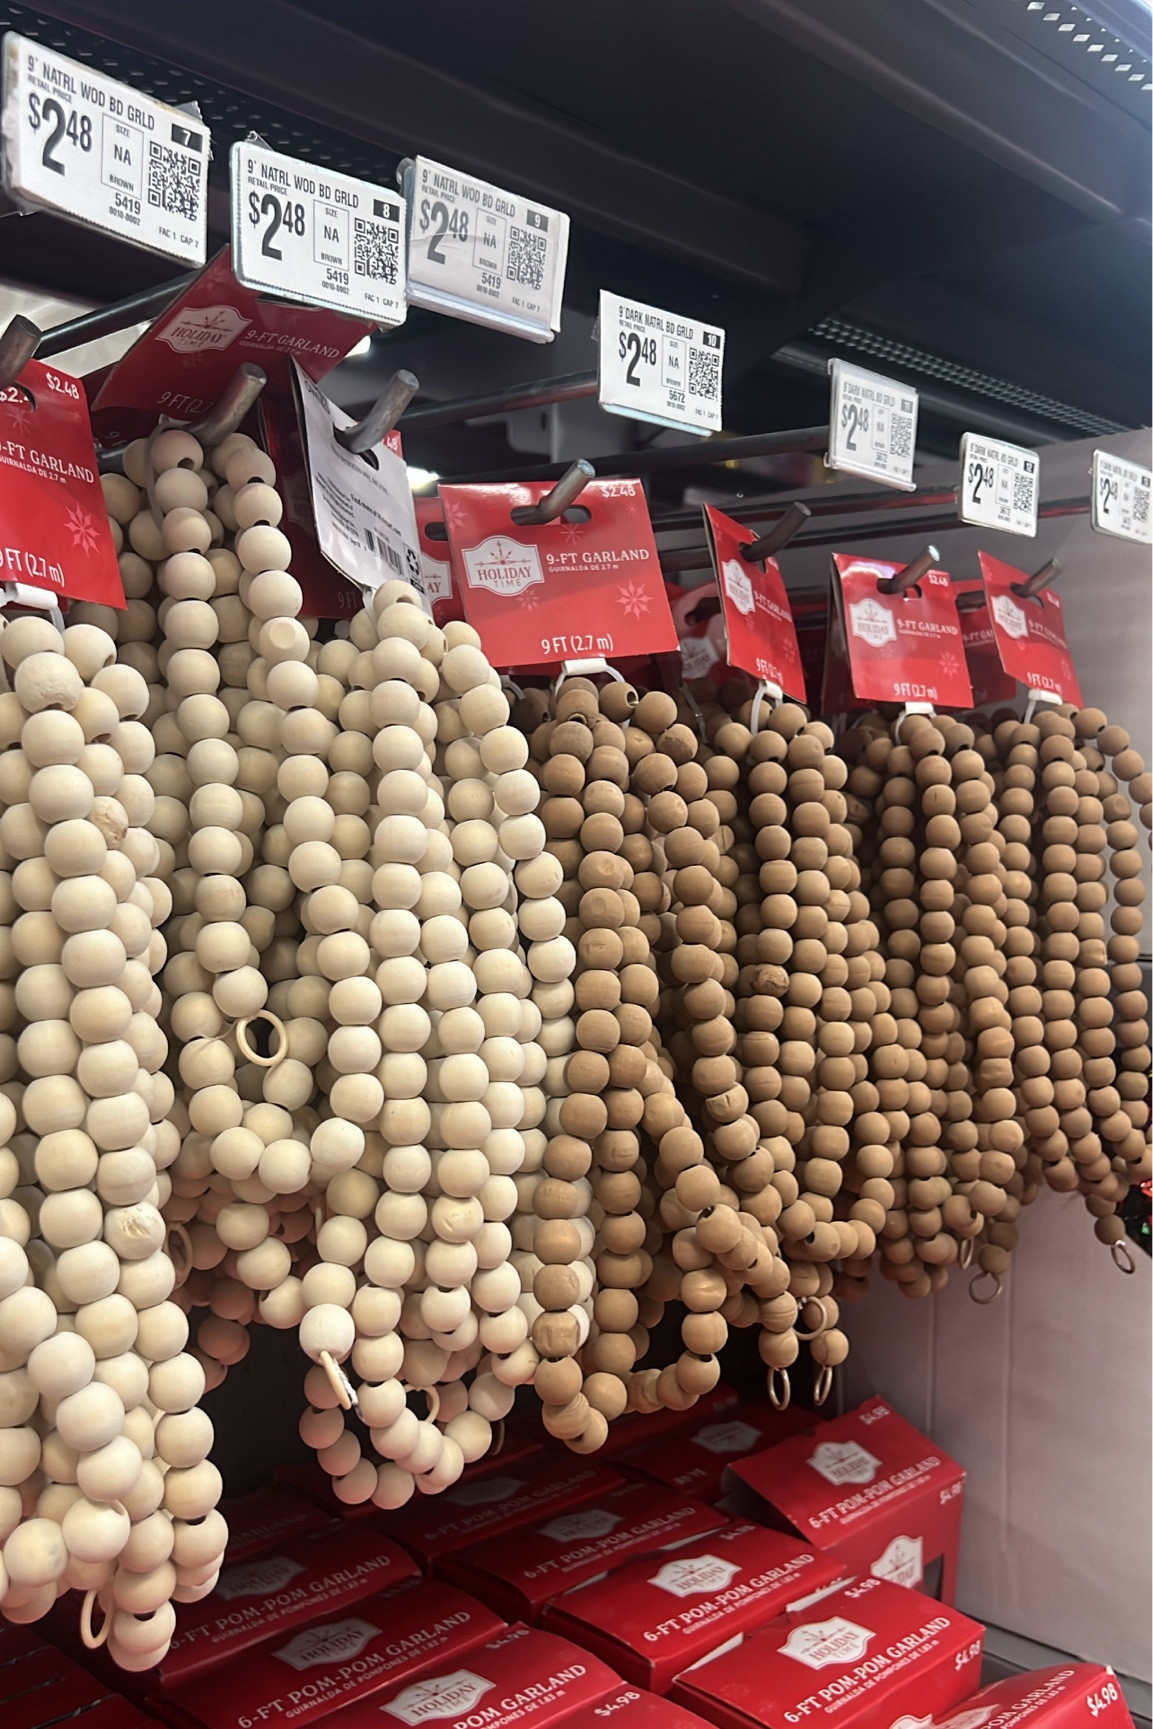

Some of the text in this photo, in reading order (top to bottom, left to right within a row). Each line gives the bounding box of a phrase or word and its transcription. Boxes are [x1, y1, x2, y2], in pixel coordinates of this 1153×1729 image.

[28, 74, 72, 104] RETAIL PRICE
[43, 62, 77, 94] NATRL
[80, 81, 106, 107] WOD
[109, 96, 124, 116] BD
[127, 105, 155, 130] GRLD
[116, 124, 130, 138] SIZE
[182, 130, 192, 146] 7
[114, 144, 132, 166] NA
[109, 174, 134, 192] BROWN
[248, 177, 287, 196] RETAIL PRICE
[261, 164, 291, 187] NATRL
[294, 175, 316, 195] WOD
[319, 184, 331, 200] BD
[335, 189, 359, 209] GRLD
[115, 192, 141, 215] 5419
[434, 174, 459, 196] NATRL
[462, 184, 480, 204] WOD
[482, 192, 494, 208] BD
[495, 199, 516, 218] GRLD
[325, 207, 338, 218] SIZE
[383, 203, 391, 219] 8
[534, 215, 541, 228] 9
[324, 225, 340, 243] NA
[483, 232, 497, 249] NA
[321, 252, 343, 265] BROWN
[326, 268, 349, 286] 5419
[481, 272, 501, 290] 5419
[171, 327, 226, 345] HOLIDAY
[645, 314, 694, 340] NATRL BD GRLD
[245, 330, 278, 344] 9-FT
[278, 334, 340, 359] GARLAND
[707, 334, 717, 346] 10
[668, 355, 679, 369] NA
[46, 372, 79, 400] $2.48
[157, 391, 191, 409] 9 FT
[30, 450, 94, 484] GARLAND
[38, 468, 48, 480] DE
[602, 486, 636, 499] $2.48
[546, 548, 649, 565] 9-FT GARLAND
[49, 563, 65, 588] m)
[478, 567, 531, 581] HOLIDAY
[549, 565, 589, 573] GUIRNALDA
[494, 579, 522, 588] TIME
[928, 574, 949, 587] $2.48
[897, 619, 917, 630] 9-FT
[918, 621, 958, 635] GARLAND
[541, 633, 614, 655] 9 FT (2.7 m)
[894, 683, 900, 695] 9
[900, 683, 911, 697] FT
[927, 687, 938, 700] m)
[808, 1507, 839, 1529] 6-FT
[835, 1480, 894, 1514] POM-POM
[889, 1456, 941, 1485] GARLAND
[523, 1559, 560, 1579] 6-FT
[560, 1532, 633, 1564] POM-POM
[631, 1506, 696, 1536] GARLAND
[675, 1566, 727, 1590] HOLIDAY
[844, 1578, 882, 1599] $4.98
[216, 1588, 308, 1630] POM-POM
[309, 1555, 391, 1592] GARLAND
[643, 1618, 681, 1641] 6-FT
[679, 1584, 752, 1624] POM-POM
[750, 1553, 815, 1588] GARLAND
[301, 1630, 364, 1661] HOLIDAY
[808, 1631, 860, 1661] HOLIDAY
[238, 1611, 471, 1728] 6-FT POM-POM GARLAND
[784, 1617, 951, 1723] 6-FT POM-POM GARLAND
[501, 1664, 587, 1712] GARLAND
[824, 1686, 866, 1714] GUIRNALDA
[866, 1678, 876, 1689] DE
[875, 1656, 911, 1682] POMPONES
[910, 1650, 921, 1660] DE
[1011, 1670, 1075, 1710] GARLAND
[285, 1688, 343, 1718] GUIRNALDA
[343, 1680, 357, 1690] DE
[411, 1683, 476, 1717] HOLIDAY
[525, 1700, 539, 1713] DE
[594, 1691, 641, 1717] $4.98
[1086, 1682, 1118, 1717] $4.98
